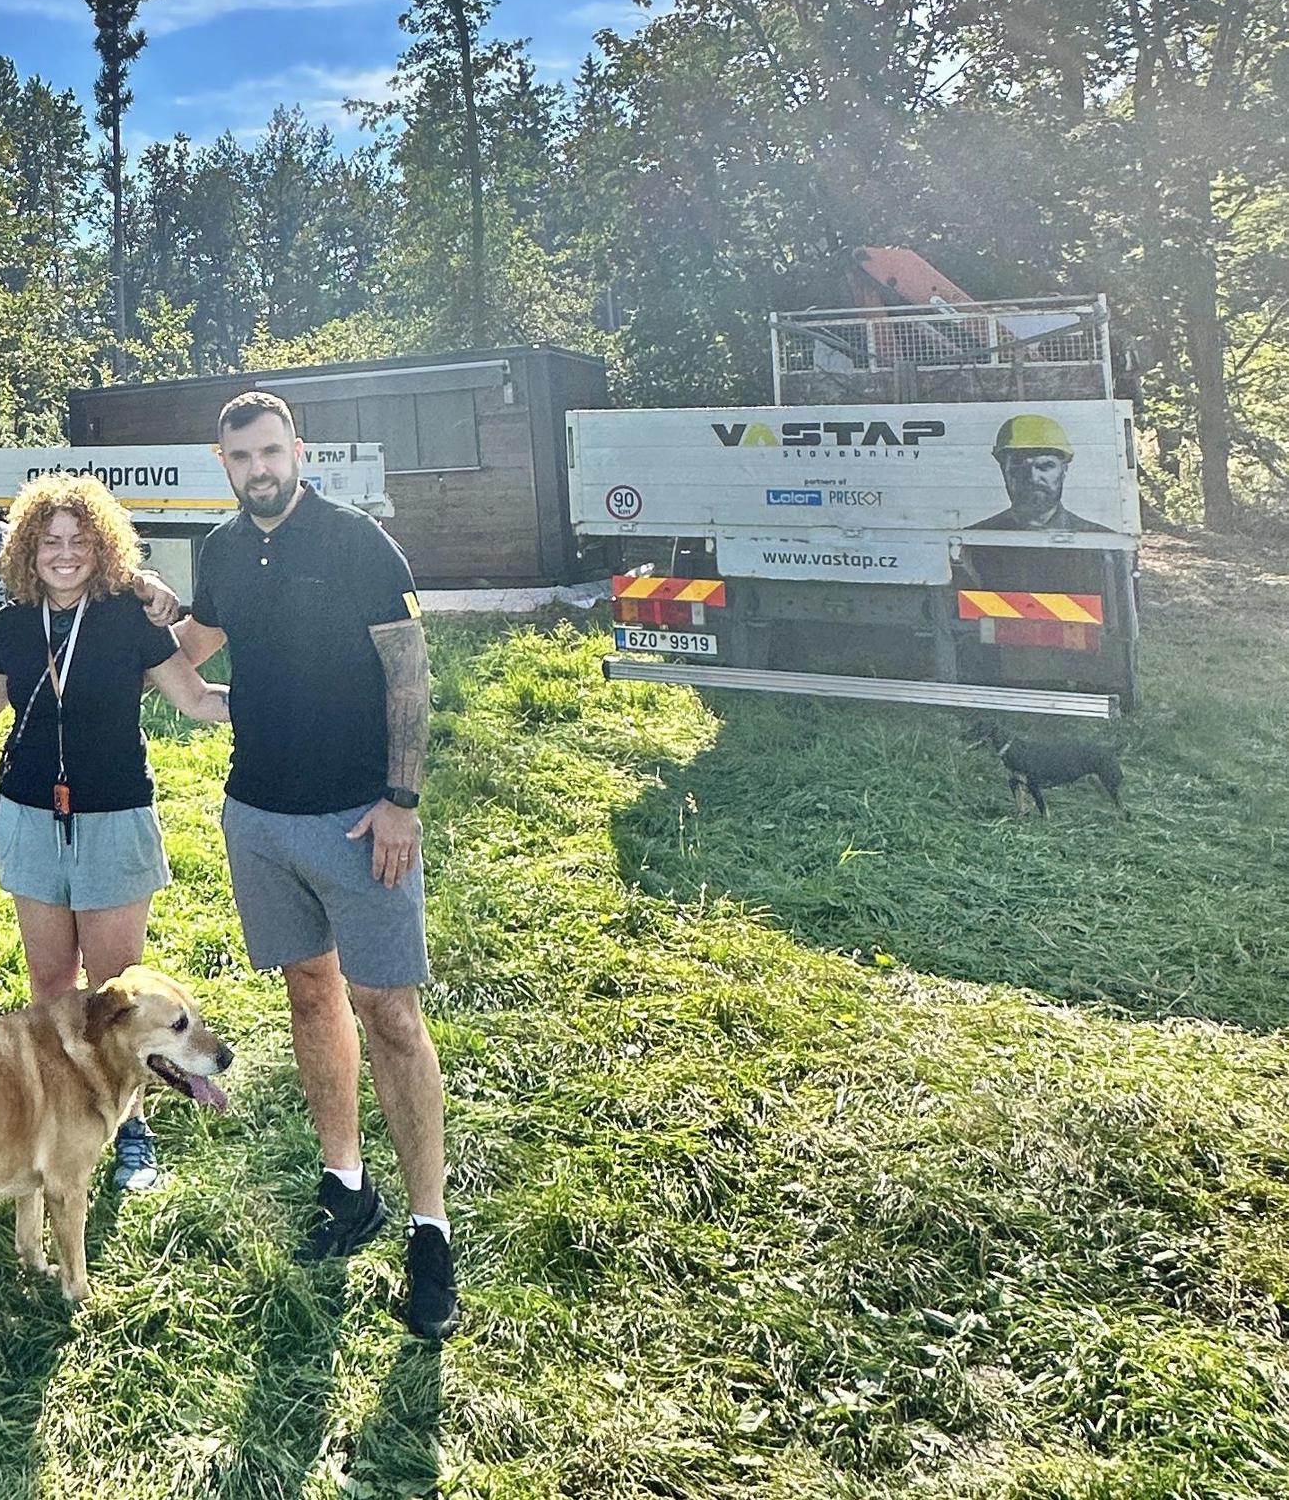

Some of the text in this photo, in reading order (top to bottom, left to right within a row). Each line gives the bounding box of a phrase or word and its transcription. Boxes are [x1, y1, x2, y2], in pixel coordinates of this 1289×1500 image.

[711, 420, 946, 447] VASTAP
[782, 448, 920, 459] stavebniny
[613, 491, 635, 508] 90
[763, 552, 899, 569] www.vastap.cz
[669, 634, 709, 651] 9919
